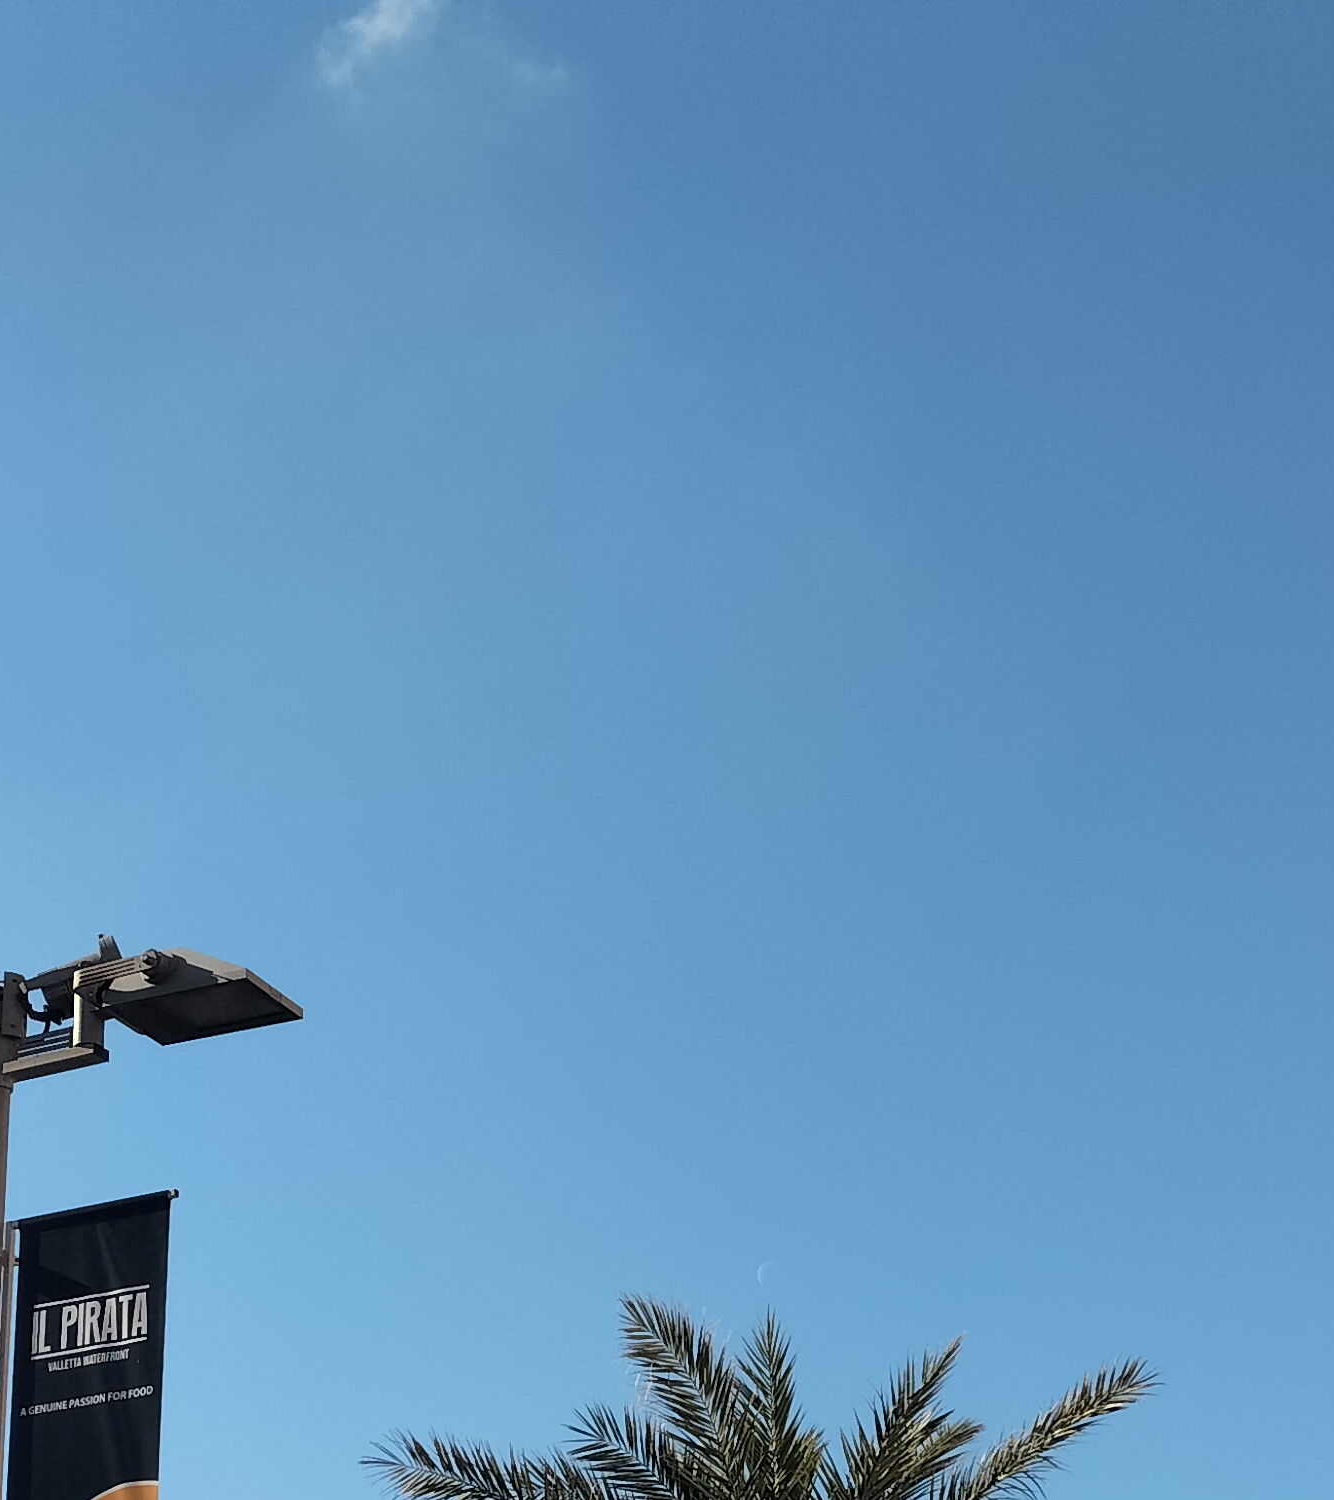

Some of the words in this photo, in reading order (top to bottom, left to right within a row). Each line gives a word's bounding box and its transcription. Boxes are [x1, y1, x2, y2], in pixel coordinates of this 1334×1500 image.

[30, 1309, 52, 1355] IL
[60, 1291, 148, 1350] PIRATA
[47, 1356, 82, 1373] VALLETTA
[82, 1348, 130, 1367] WATERFRONT
[19, 1407, 27, 1417] A
[28, 1400, 68, 1416] GENUINE
[68, 1392, 106, 1409] PASSION
[107, 1389, 127, 1402] FOR
[128, 1385, 154, 1400] FOOD
